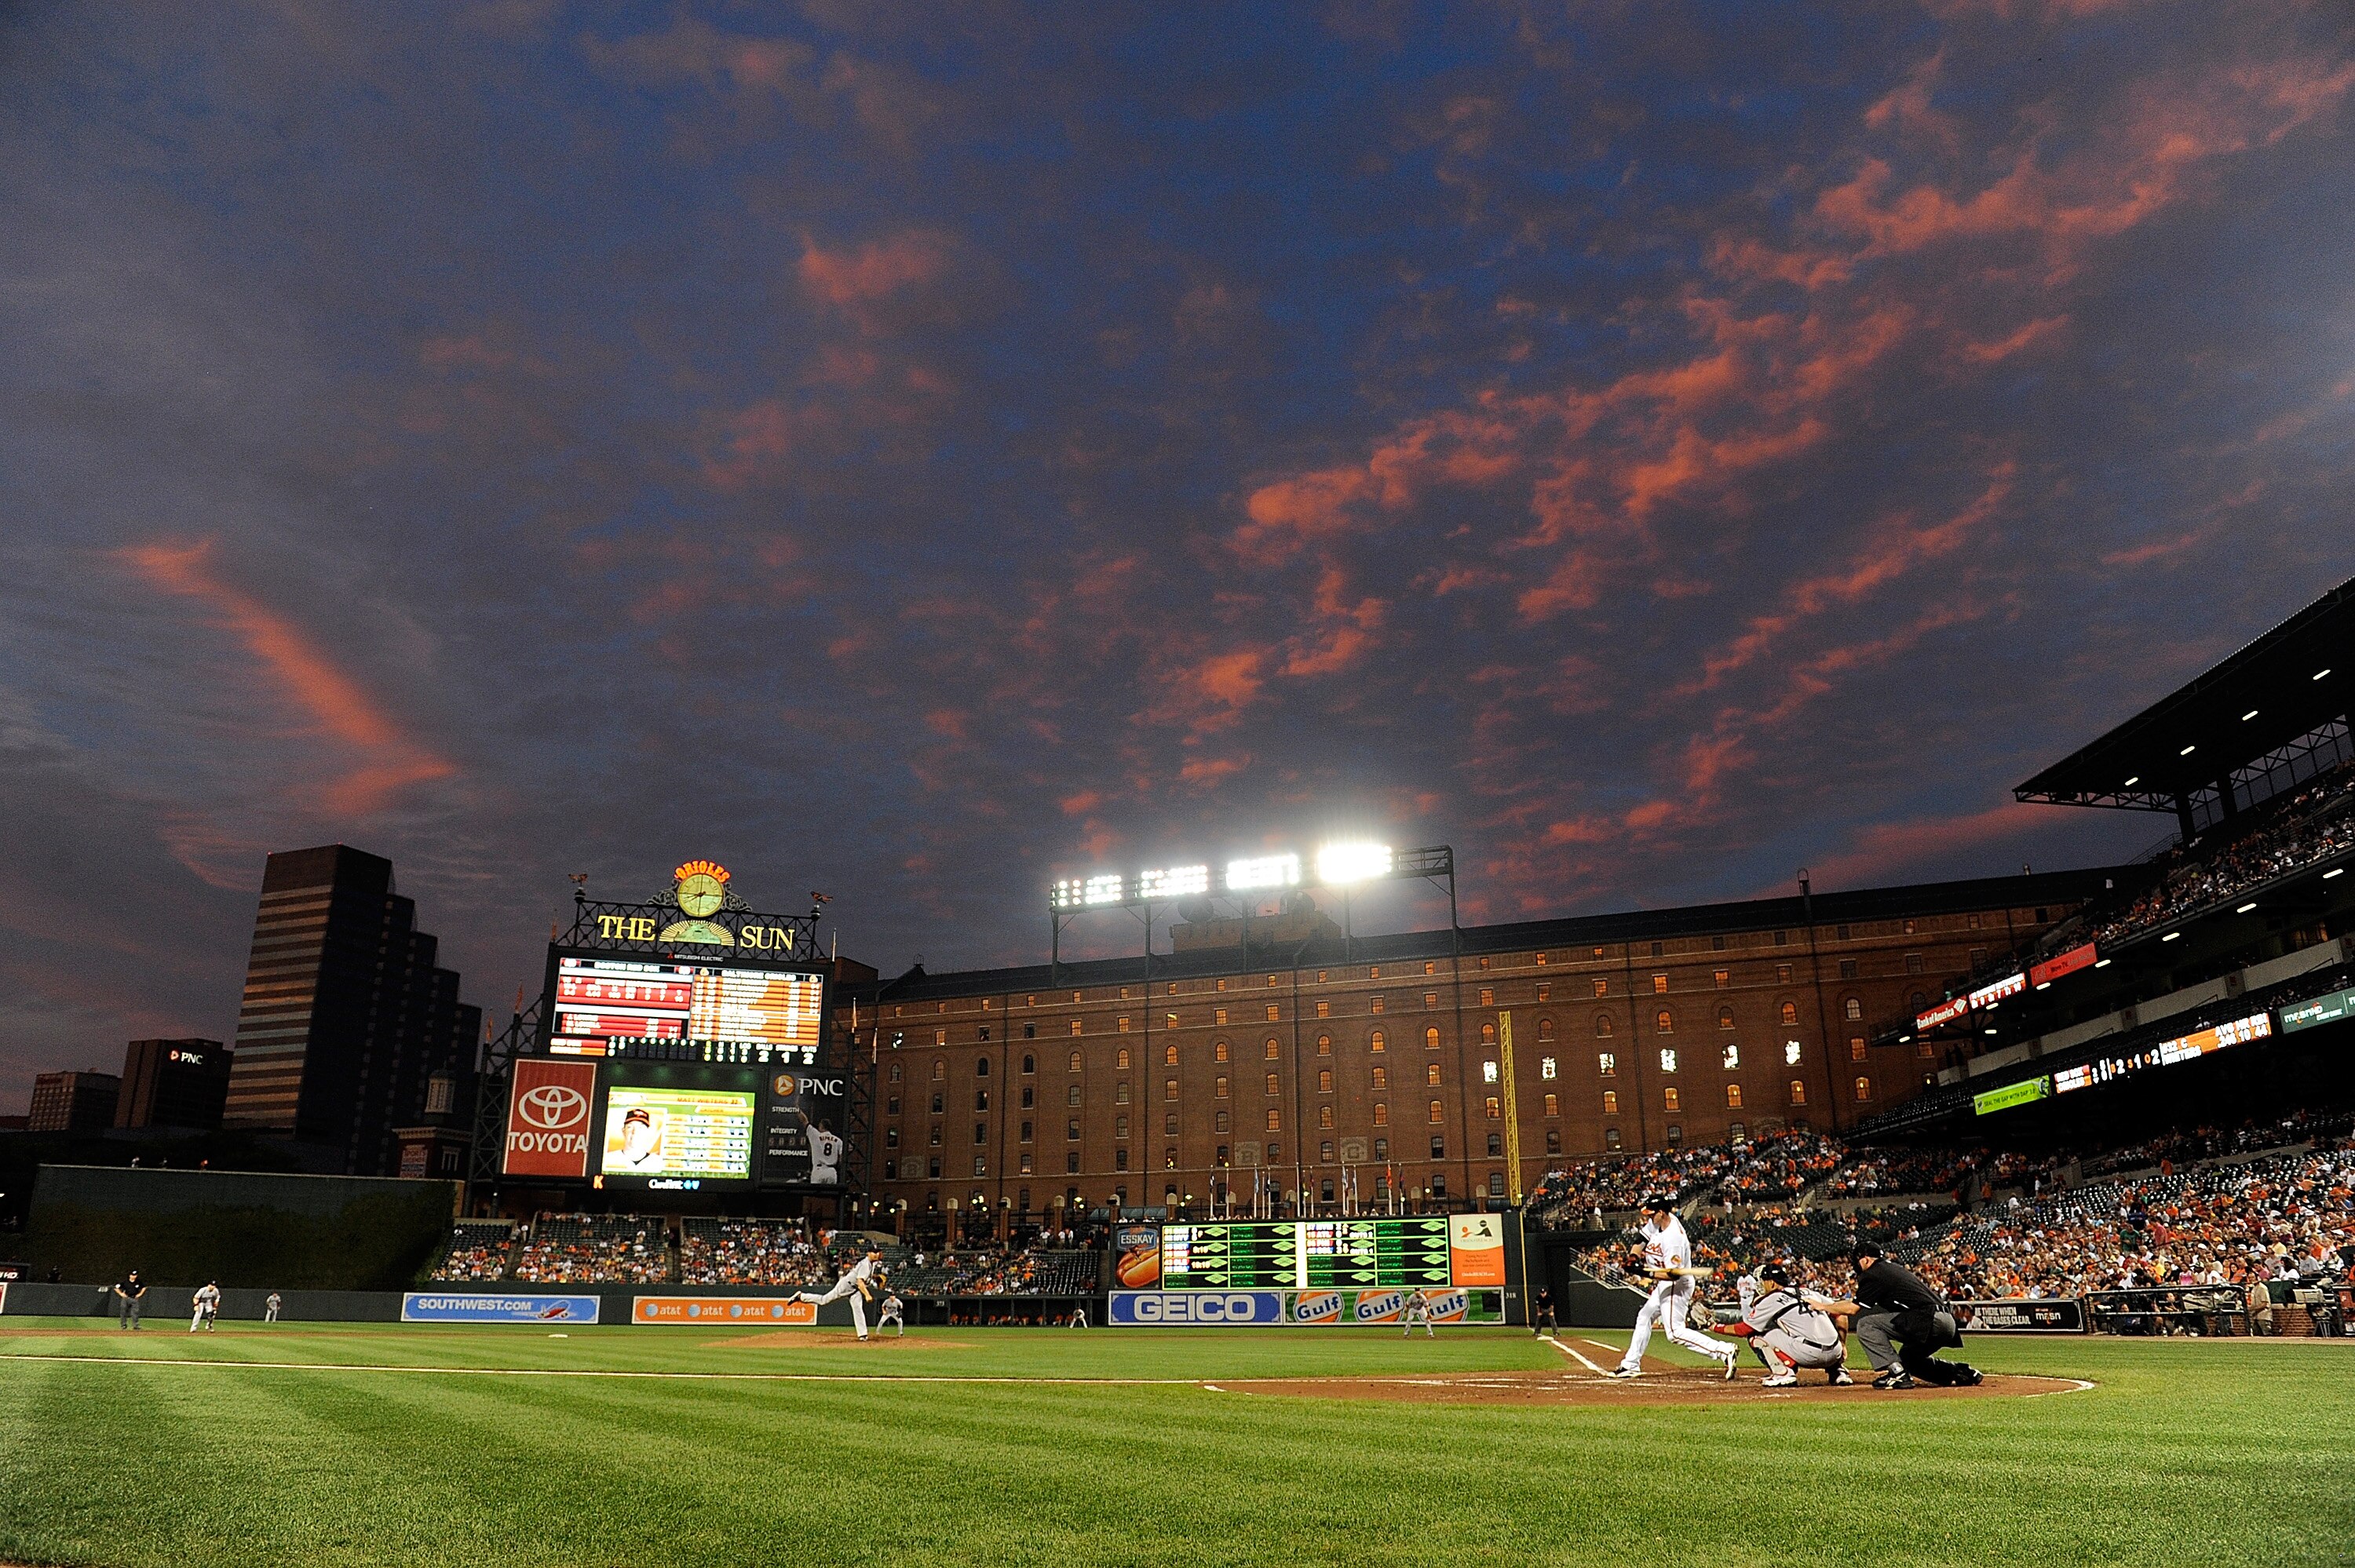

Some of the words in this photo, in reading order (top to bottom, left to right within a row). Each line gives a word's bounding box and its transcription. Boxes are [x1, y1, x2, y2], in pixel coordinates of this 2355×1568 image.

[674, 860, 730, 882] ORIOLES
[597, 915, 655, 941] THE
[739, 925, 794, 950] SUN
[1916, 1016, 1930, 1029] Bank
[1934, 1008, 1955, 1023] America
[2215, 1023, 2235, 1037] AVG
[2180, 1037, 2188, 1049] C
[181, 1052, 203, 1065] PNC
[758, 1050, 769, 1063] 2
[781, 1052, 790, 1064] 1
[802, 1052, 814, 1065] 2
[2116, 1059, 2126, 1074] 2
[2127, 1059, 2134, 1069] S
[2134, 1053, 2141, 1069] 1
[2150, 1048, 2160, 1065] 2
[798, 1078, 844, 1096] PNC
[508, 1131, 587, 1153] TOYOTA
[823, 1143, 832, 1156] 8
[593, 1175, 604, 1189] K
[1120, 1234, 1154, 1244] ESSKAY
[418, 1298, 531, 1311] SOUTHWEST.COM
[659, 1305, 681, 1315] at&t
[702, 1305, 723, 1315] at&t
[744, 1305, 765, 1315] at&t
[785, 1306, 805, 1316] at&t
[1134, 1294, 1256, 1321] GEICO
[1297, 1296, 1341, 1318] Gulf
[1357, 1294, 1400, 1318] Gulf
[1429, 1294, 1464, 1317] ulf
[1974, 1307, 1981, 1316] BE
[1981, 1307, 1999, 1316] THERE
[1999, 1307, 2017, 1315] WHEN
[1982, 1316, 1993, 1325] THE
[1994, 1316, 2010, 1325] BASES
[2035, 1311, 2061, 1321] masn
